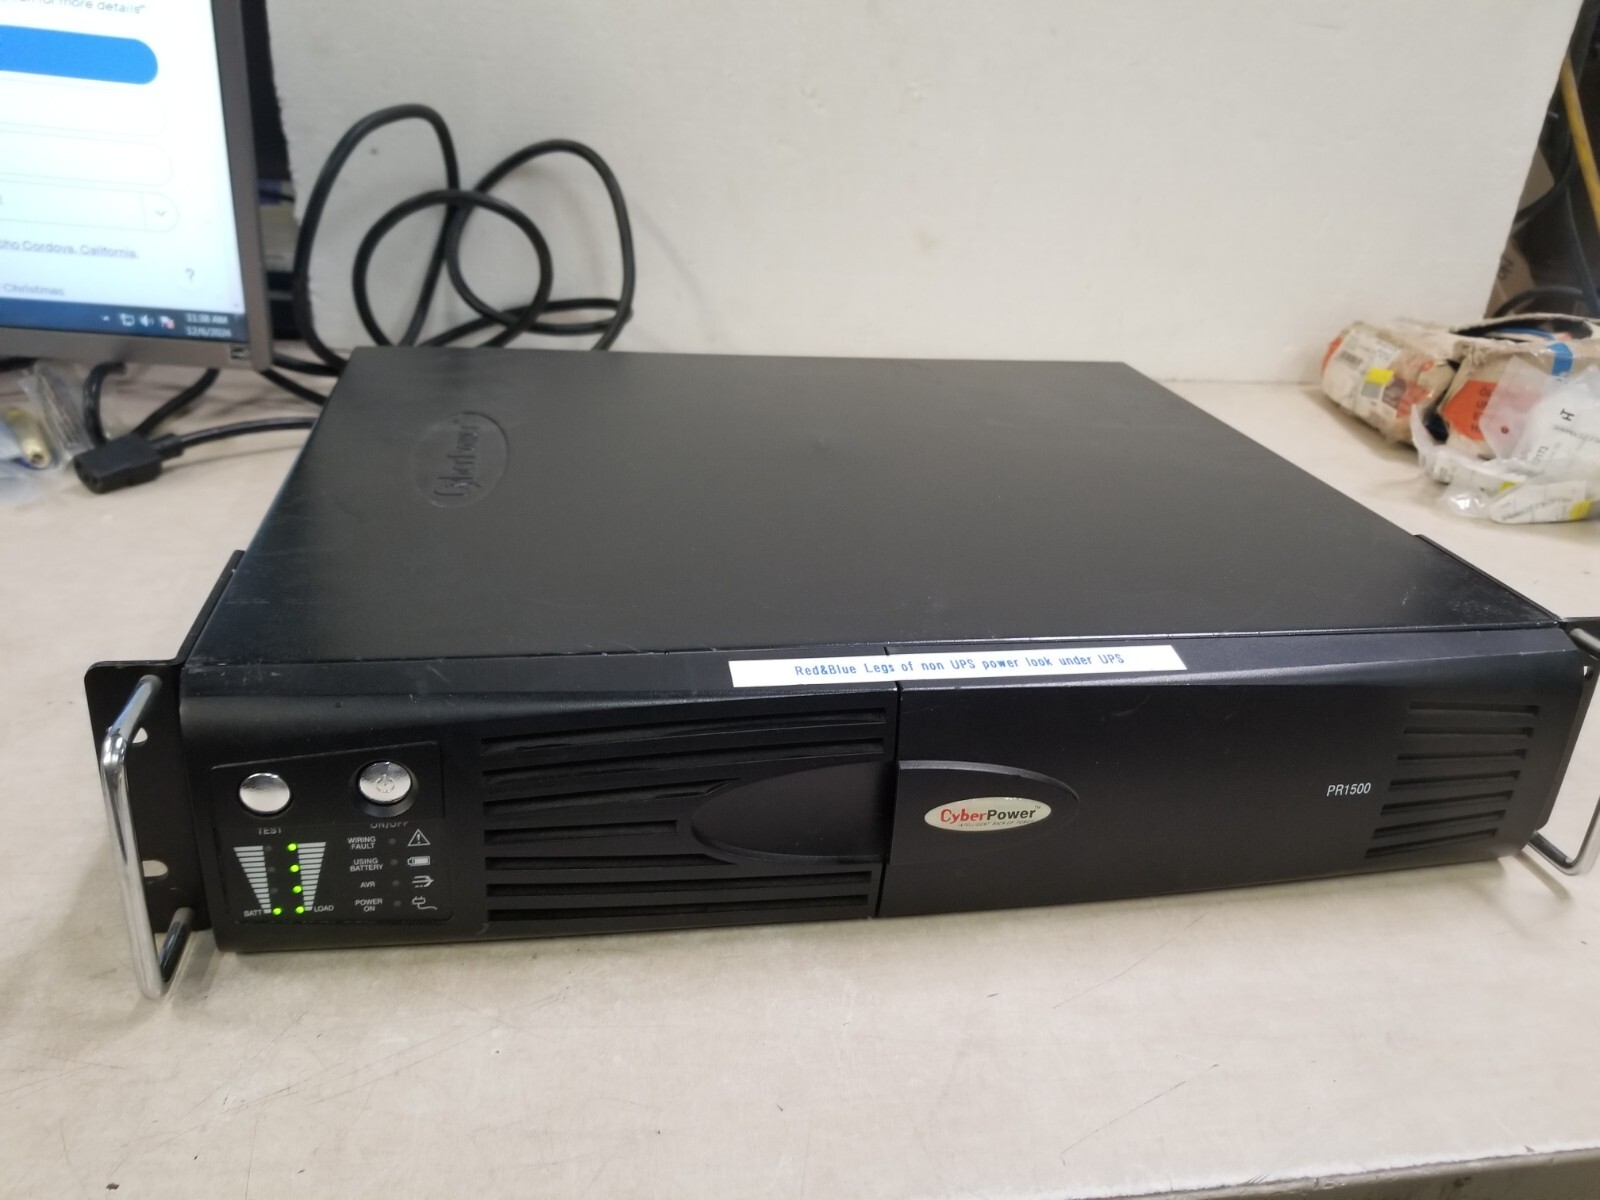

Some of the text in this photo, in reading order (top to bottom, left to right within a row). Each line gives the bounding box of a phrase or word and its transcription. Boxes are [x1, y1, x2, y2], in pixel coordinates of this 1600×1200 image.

[794, 653, 1125, 676] Red&Blue Legs of non UPS power look under UPS
[1326, 782, 1371, 797] PR1500
[940, 808, 1036, 825] CyberPower
[257, 826, 283, 836] TEST
[347, 836, 377, 844] WIRING
[351, 842, 375, 850] FAULT
[353, 857, 379, 866] USING
[350, 864, 384, 872] BATTERY
[355, 898, 383, 906] POWER
[243, 909, 262, 917] BATT
